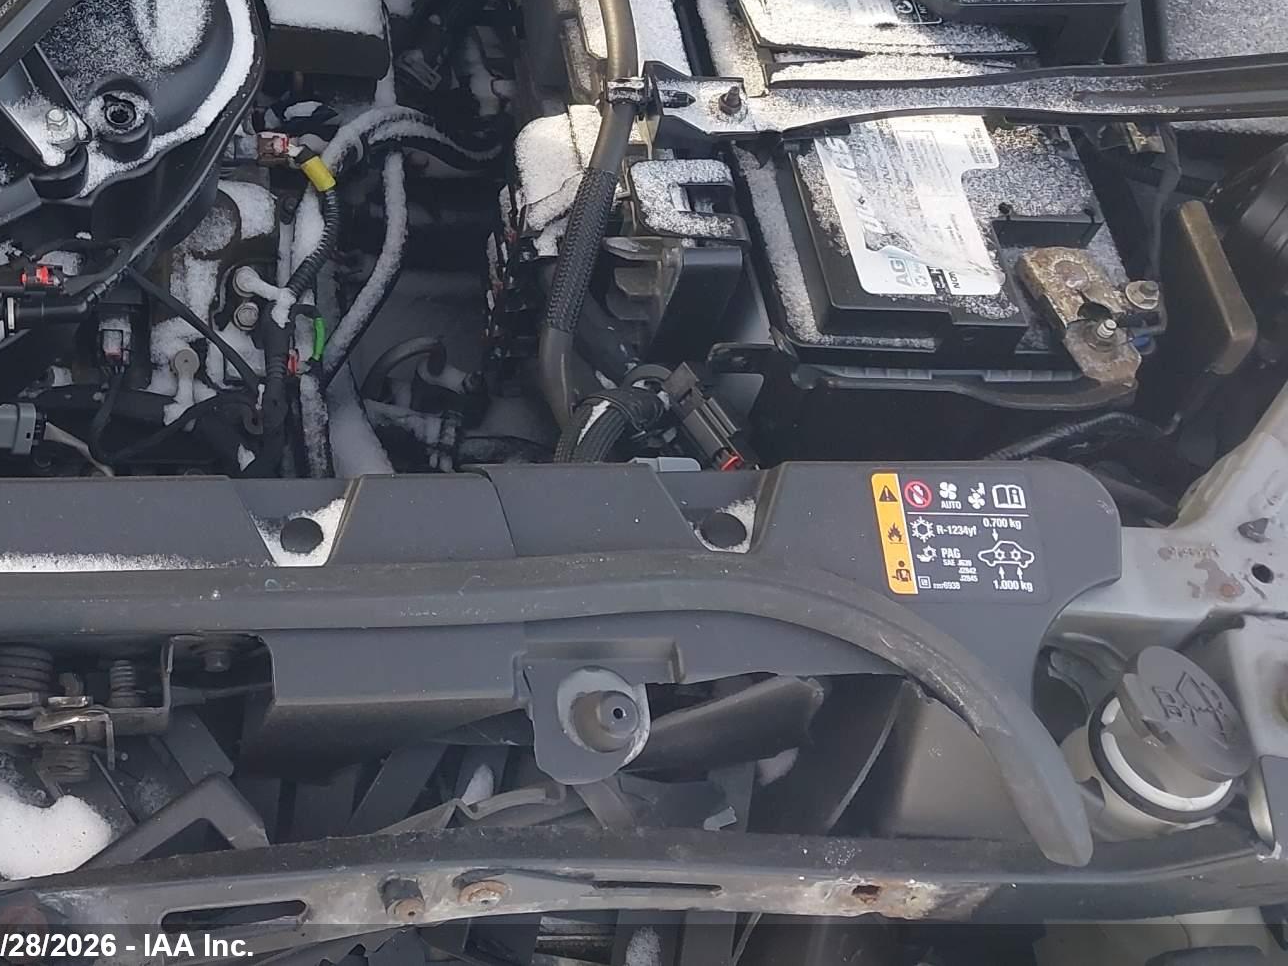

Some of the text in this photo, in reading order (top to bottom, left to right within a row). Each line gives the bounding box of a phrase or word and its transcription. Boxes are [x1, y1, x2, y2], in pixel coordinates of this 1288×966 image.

[940, 500, 962, 510] AUTO
[982, 517, 1022, 531] 0.700 kg
[936, 525, 977, 537] R-1234yf
[940, 547, 962, 559] PAG
[992, 579, 1034, 593] 1.000 kg
